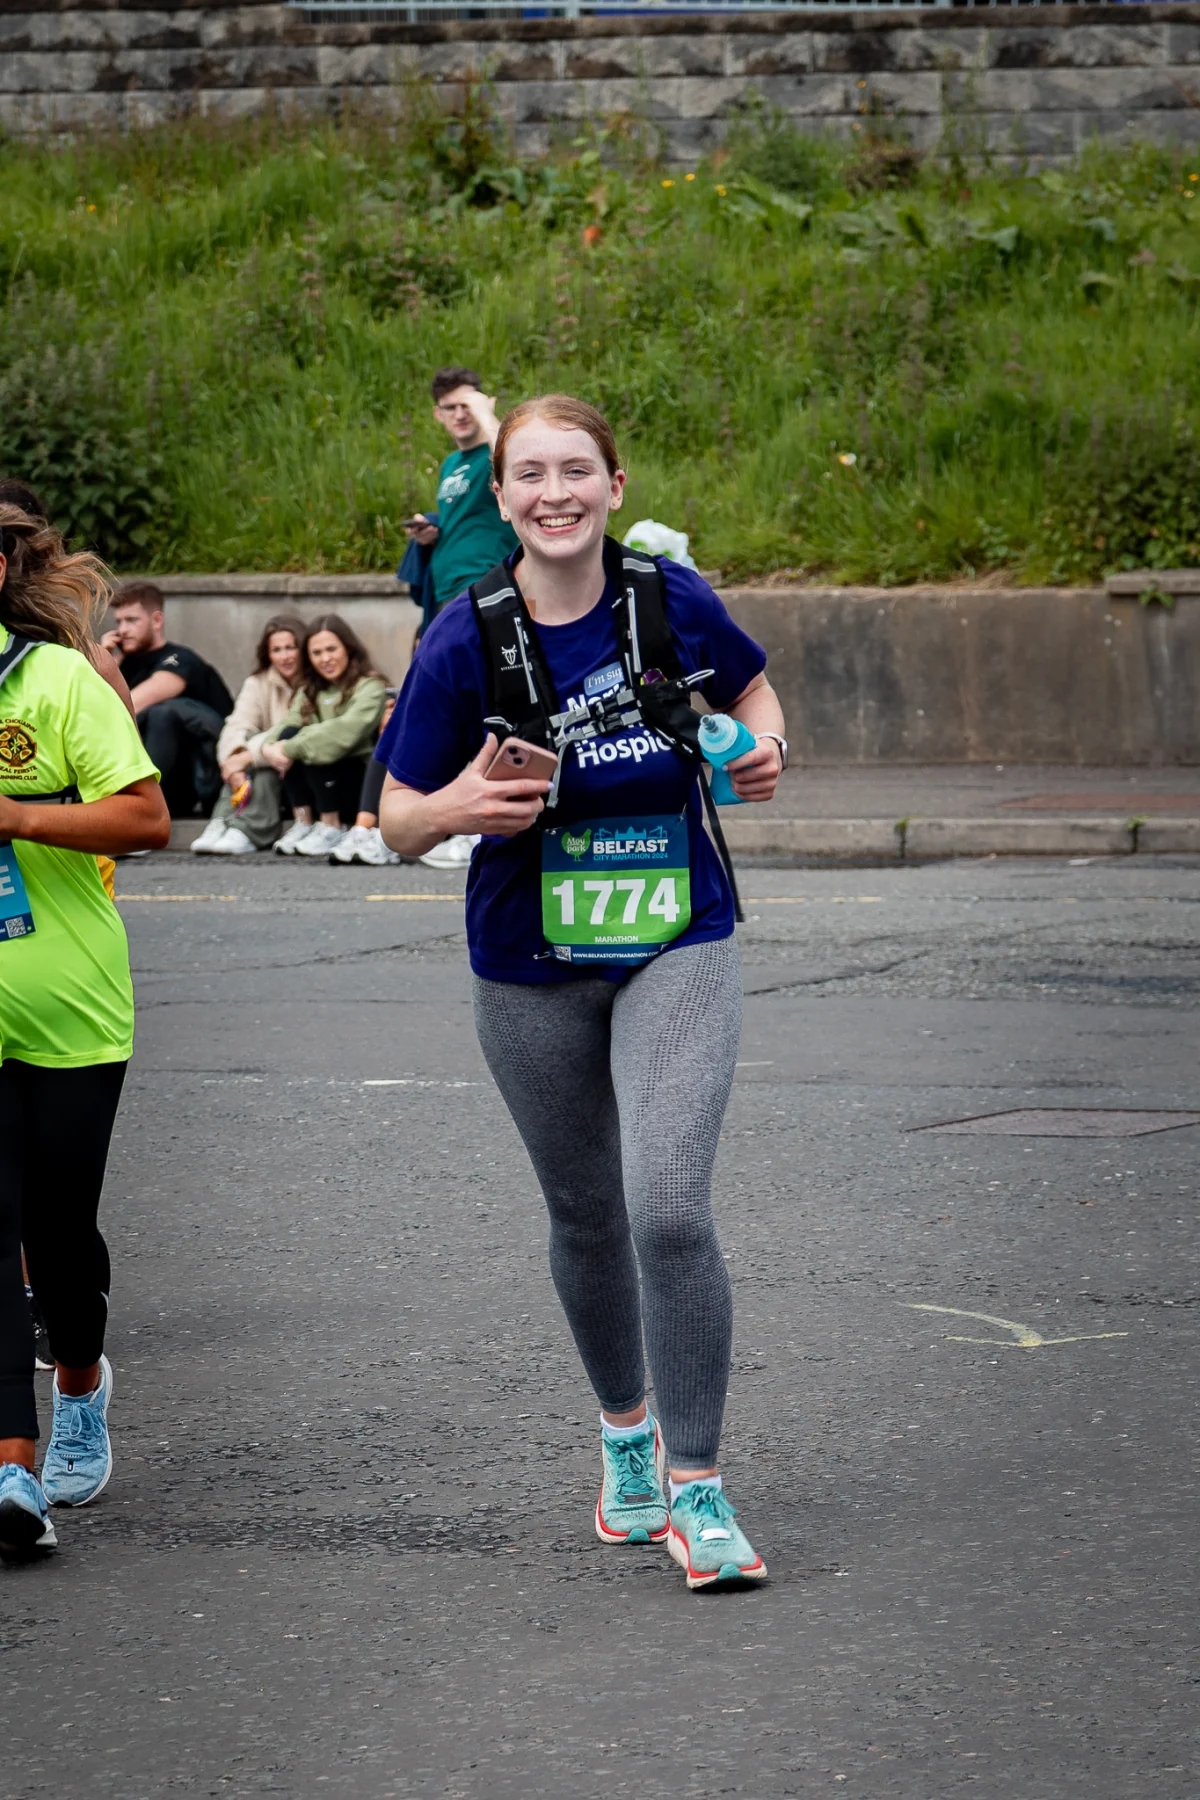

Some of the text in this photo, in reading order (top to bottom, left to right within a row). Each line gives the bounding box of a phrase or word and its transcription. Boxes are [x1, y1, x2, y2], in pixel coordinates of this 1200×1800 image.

[588, 674, 605, 689] I'm
[574, 730, 672, 768] Hospic
[566, 837, 585, 845] Moy
[593, 839, 668, 854] BELFAST
[566, 844, 586, 853] park
[611, 853, 650, 861] MARATHON
[552, 877, 680, 925] 1774
[594, 935, 639, 943] MARATHON
